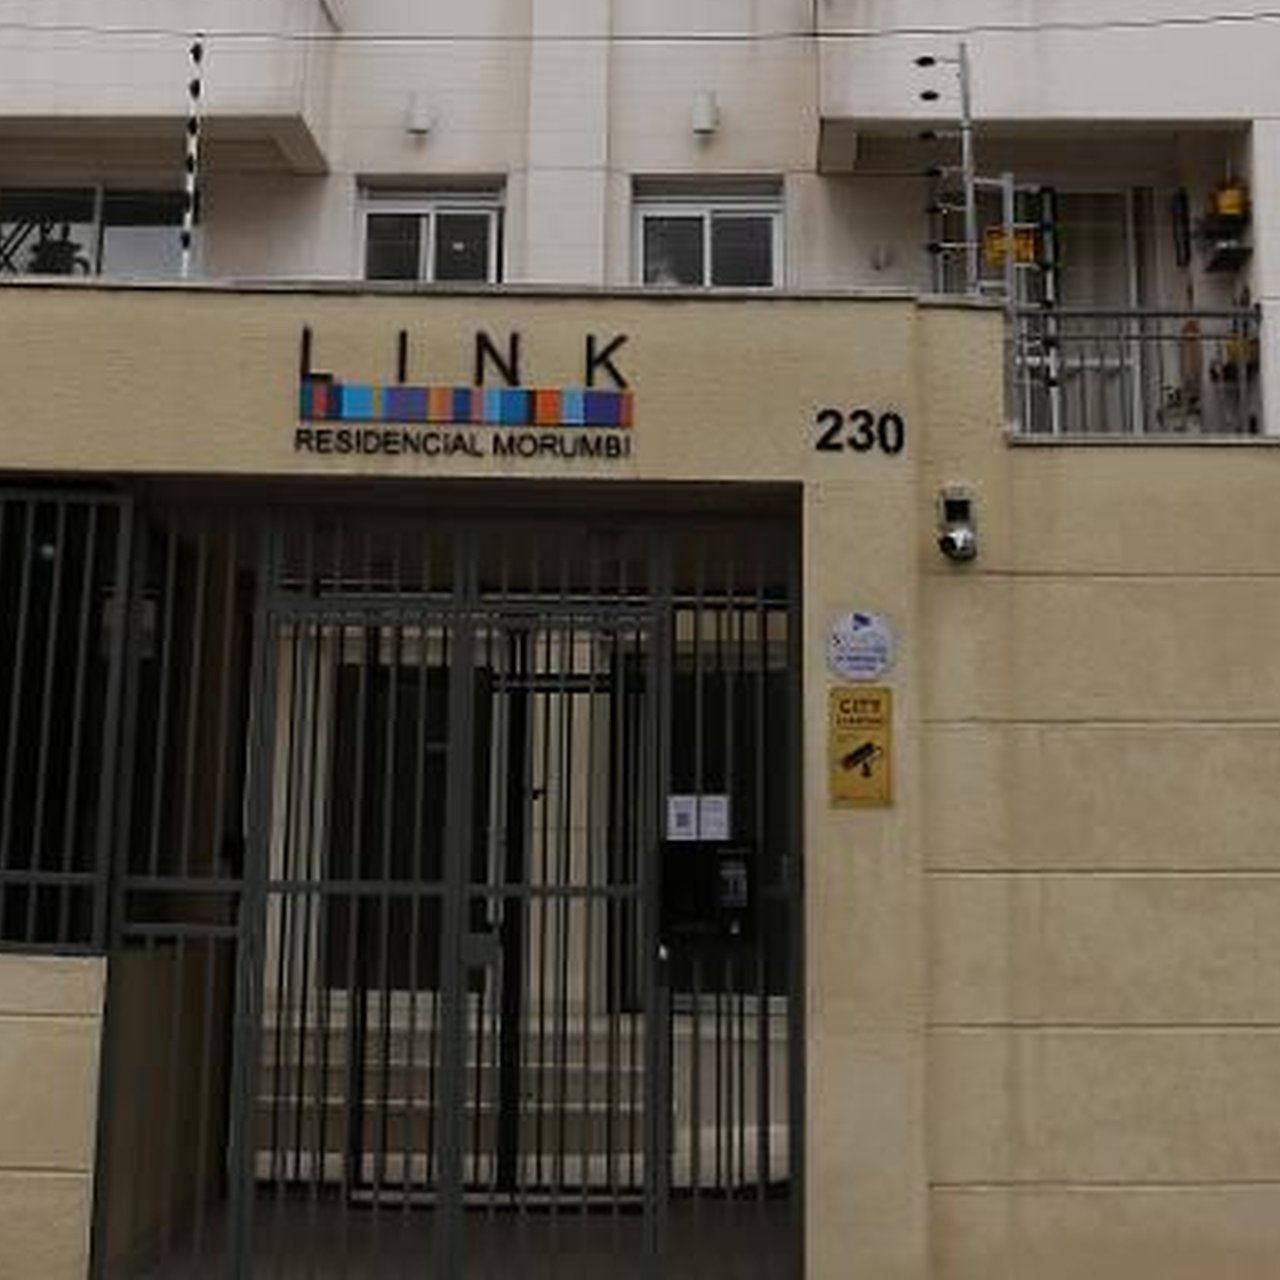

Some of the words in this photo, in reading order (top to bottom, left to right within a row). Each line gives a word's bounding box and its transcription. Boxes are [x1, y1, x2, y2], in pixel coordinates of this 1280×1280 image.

[299, 325, 629, 389] LINK
[294, 428, 484, 457] RESIDENCIAL
[492, 432, 632, 458] MORUMBI
[815, 408, 905, 455] 230
